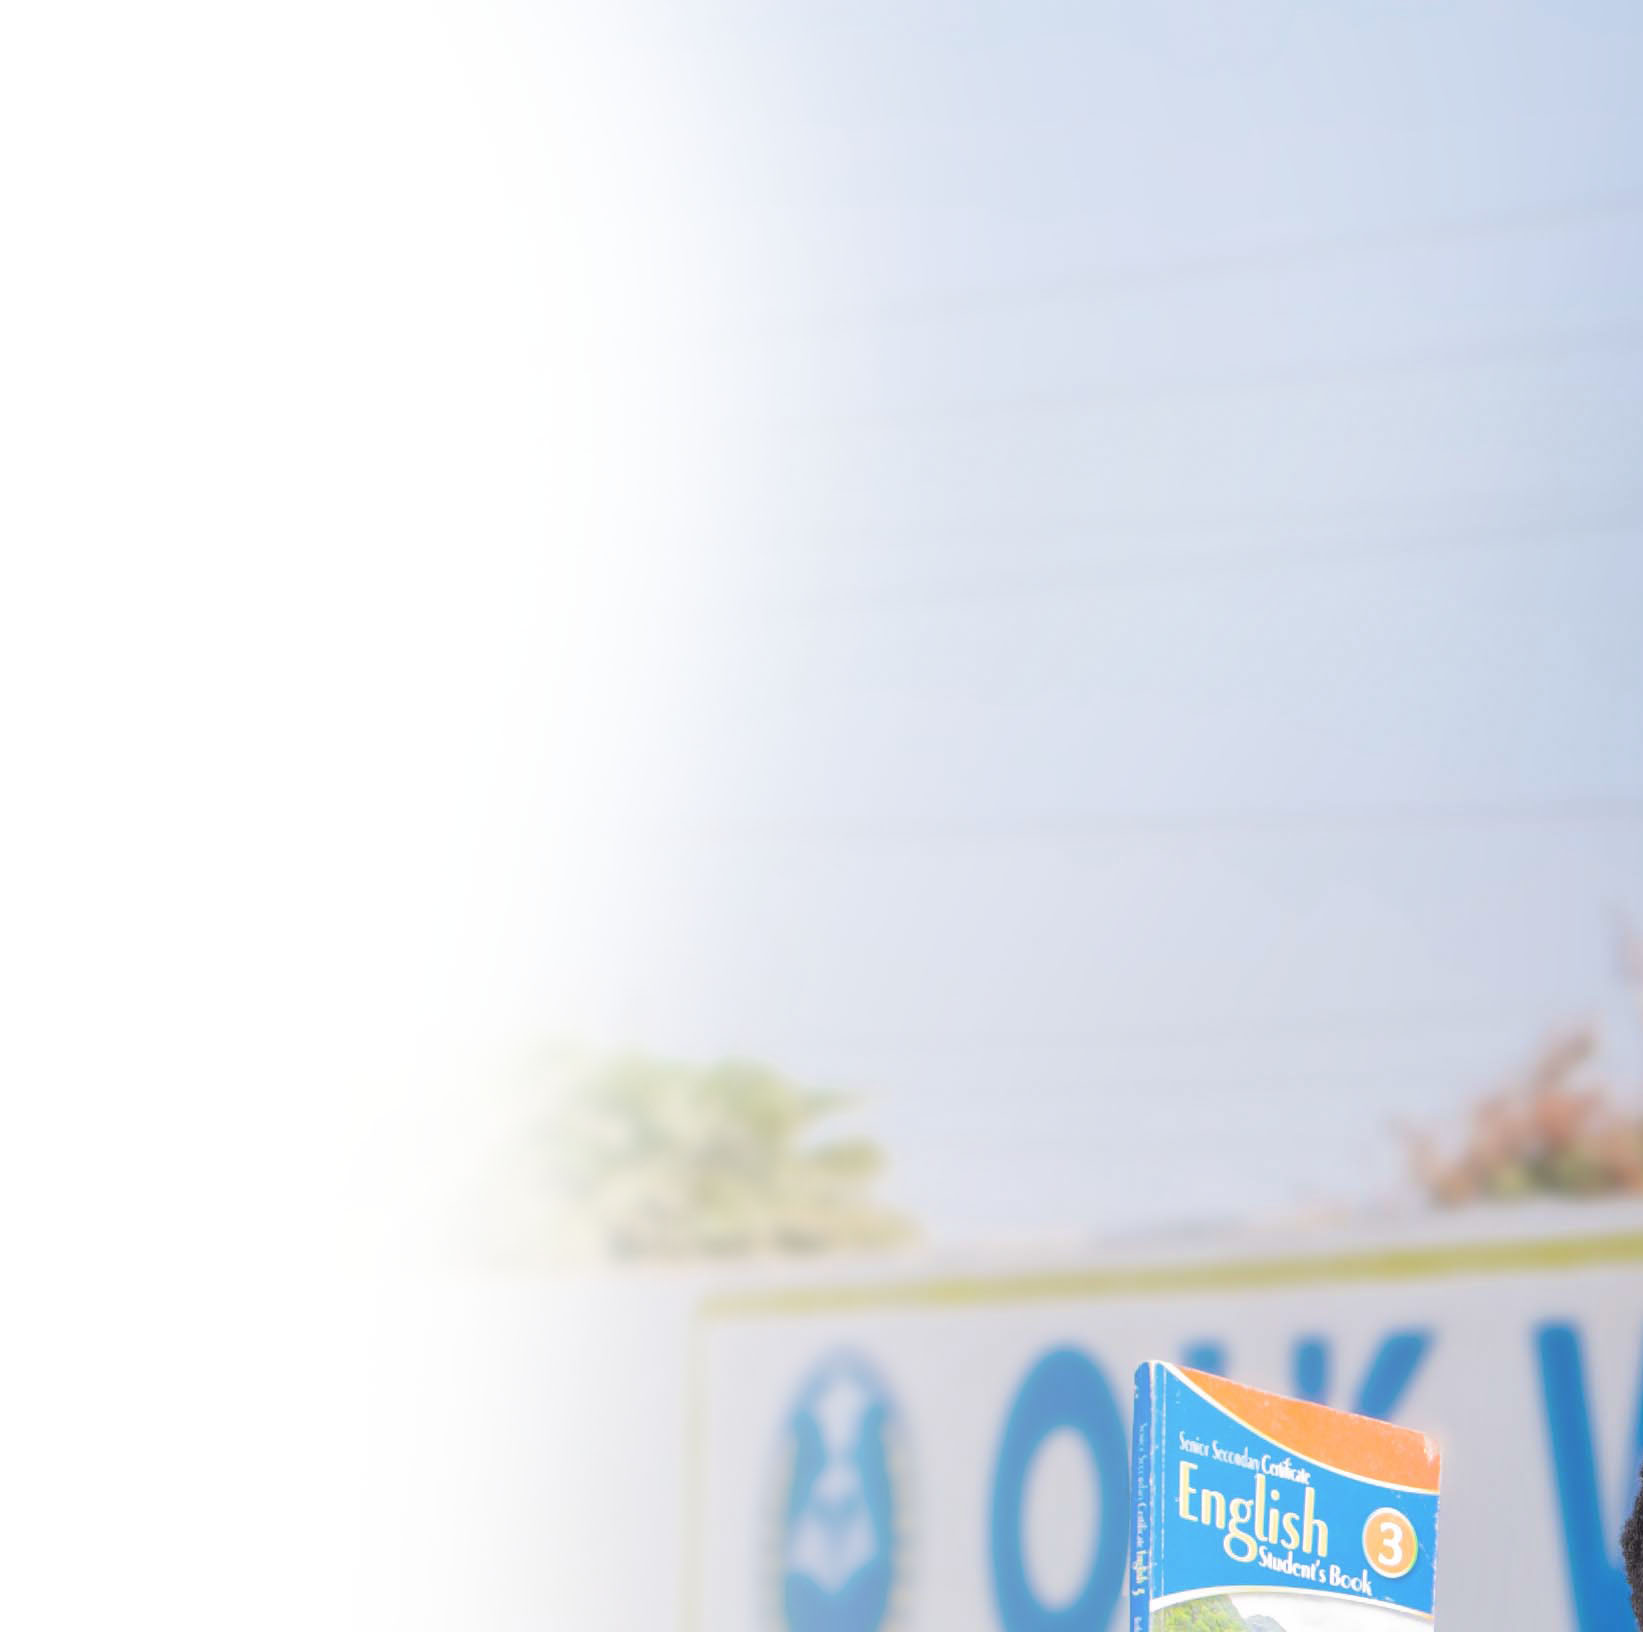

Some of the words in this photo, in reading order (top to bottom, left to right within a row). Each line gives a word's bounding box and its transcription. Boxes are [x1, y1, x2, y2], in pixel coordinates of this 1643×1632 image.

[1178, 1430, 1210, 1457] Senior
[1211, 1439, 1261, 1472] Secondary
[1261, 1454, 1312, 1485] Certificate
[1178, 1460, 1329, 1563] English
[1258, 1544, 1327, 1584] Student's
[1329, 1564, 1373, 1597] Book
[1376, 1521, 1405, 1567] 3
